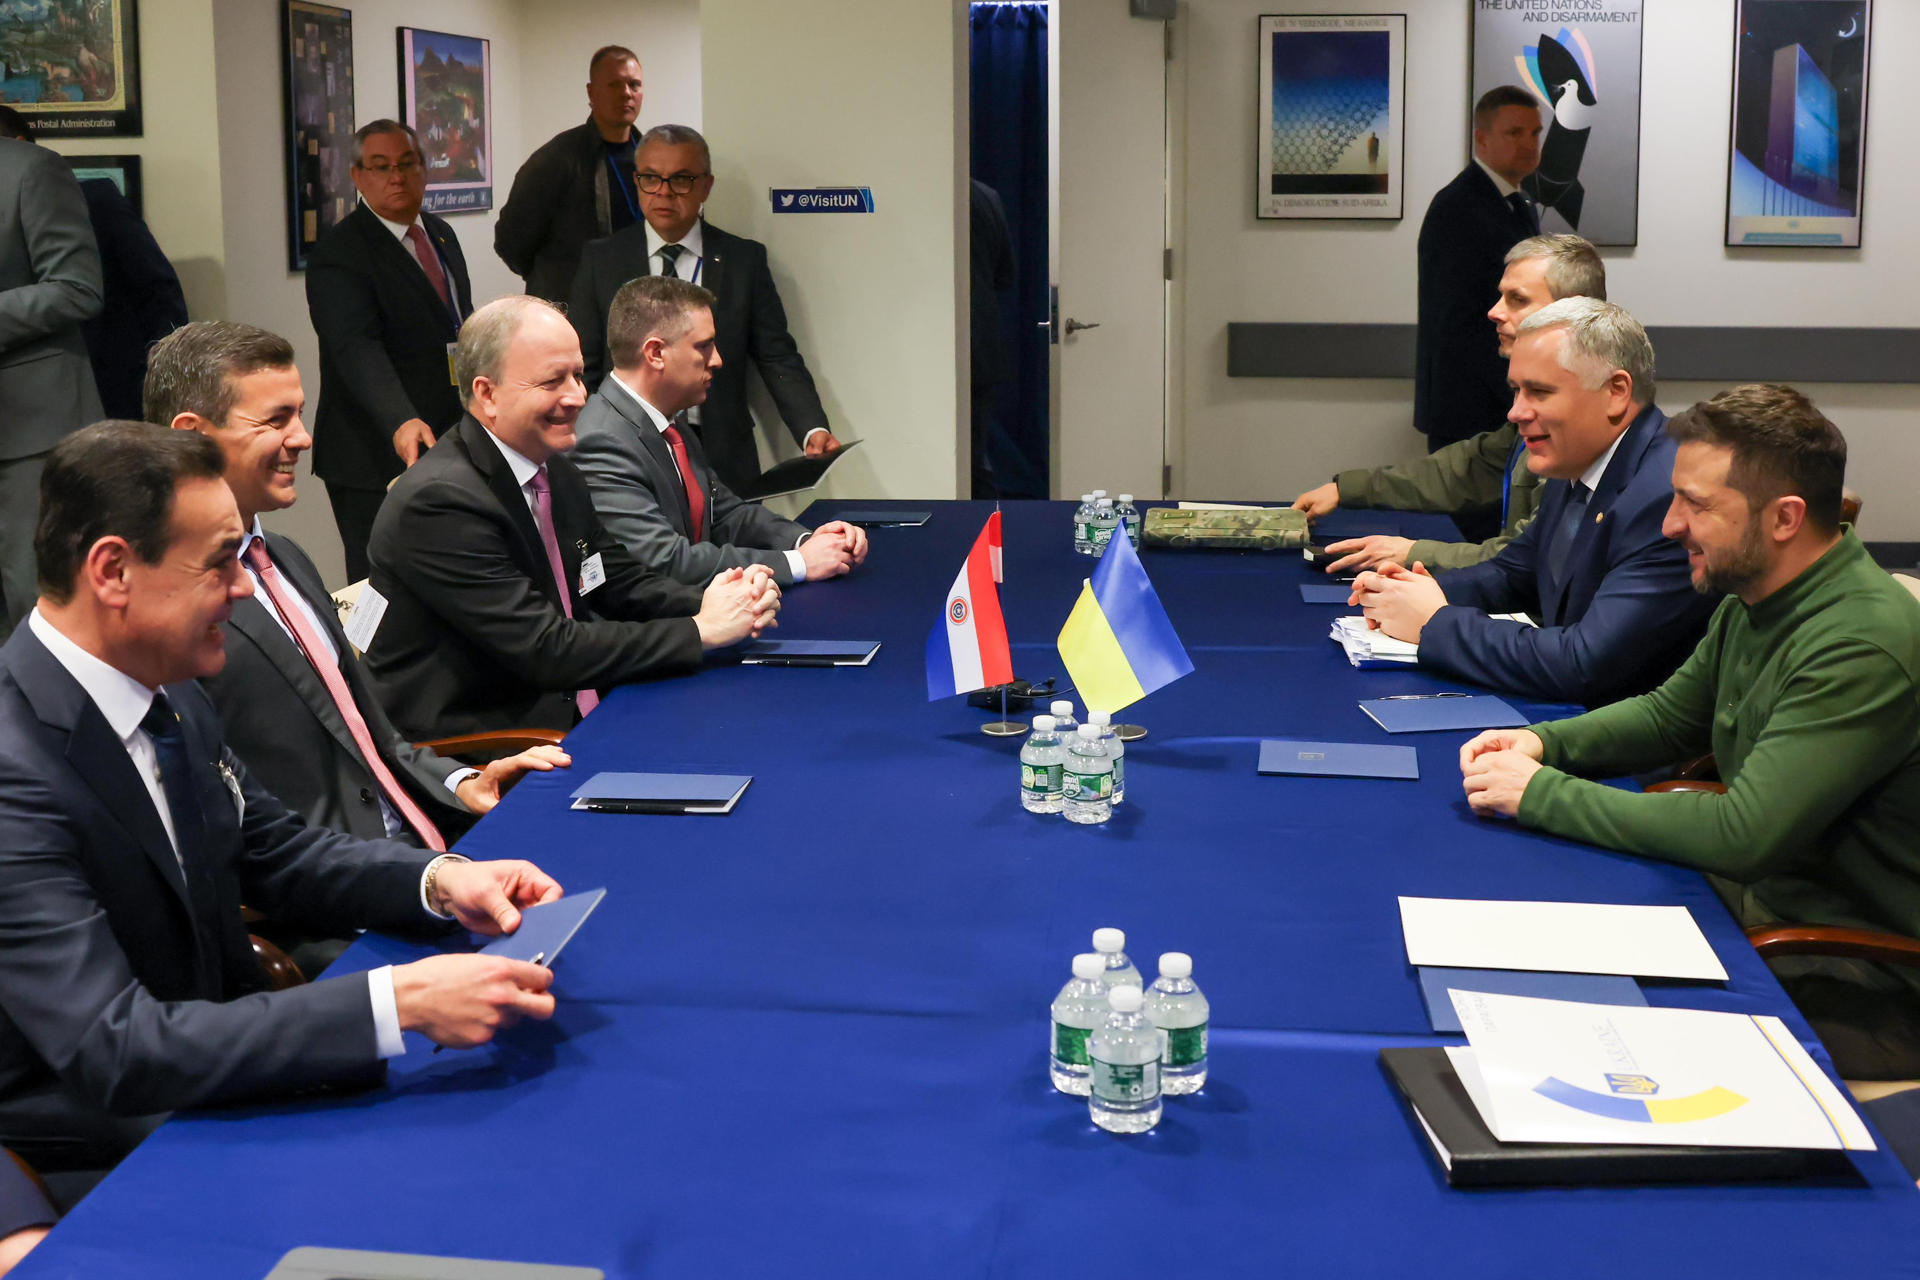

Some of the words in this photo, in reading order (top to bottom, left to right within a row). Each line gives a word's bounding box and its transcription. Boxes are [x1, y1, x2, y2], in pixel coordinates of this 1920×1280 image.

[1480, 0, 1502, 10] THE
[1504, 0, 1549, 10] UNITED
[1551, 0, 1603, 10] NATIONS
[1522, 12, 1549, 23] AND
[1551, 12, 1638, 23] DISARMAMENT
[37, 119, 59, 129] Postal
[60, 118, 116, 129] Administration
[433, 193, 446, 210] for
[446, 192, 457, 205] the
[457, 191, 476, 204] earth
[798, 194, 858, 207] @VisitUN
